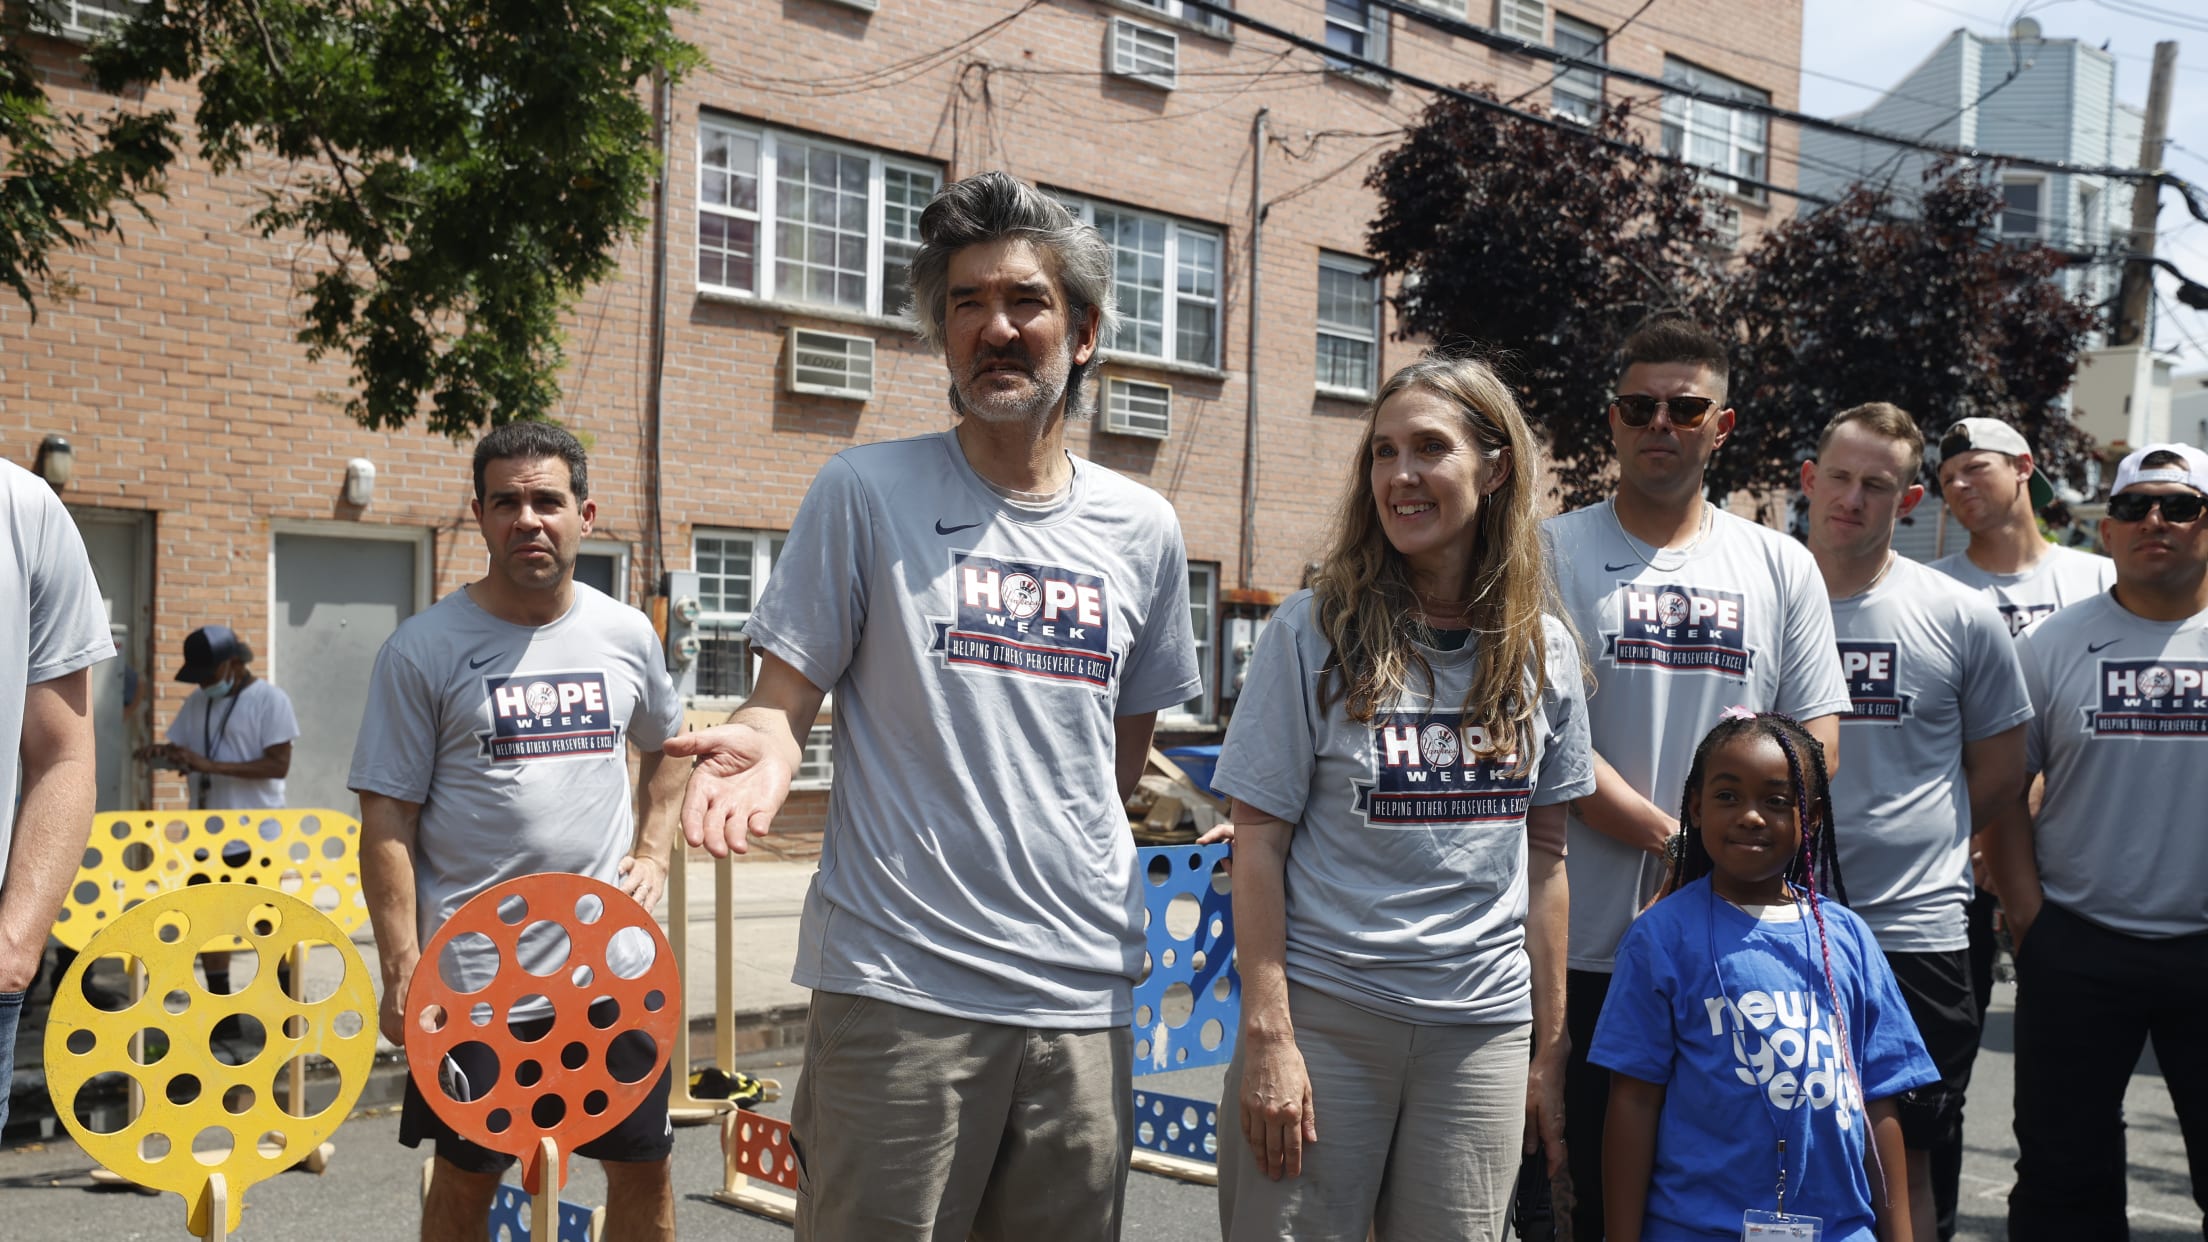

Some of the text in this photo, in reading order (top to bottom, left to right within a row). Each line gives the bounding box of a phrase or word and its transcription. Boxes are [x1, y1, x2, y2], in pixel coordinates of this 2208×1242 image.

[963, 567, 1102, 627] HOPE
[1628, 591, 1739, 629] HOPE
[985, 613, 1086, 640] WEEK
[1645, 624, 1723, 639] WEEK
[953, 640, 1106, 679] HELPING OTHERS PERSEVERE & EXCEL
[1619, 645, 1649, 659] HELPING
[1673, 651, 1713, 664] PERSEVERE
[1714, 653, 1719, 665] &
[1721, 655, 1742, 670] EXCEL
[1843, 652, 1890, 680] PE
[495, 681, 604, 718] HOPE
[1875, 704, 1896, 715] EXCEL
[2123, 699, 2207, 708] WEEK
[516, 714, 593, 728] WEEK
[2099, 718, 2129, 730] HELPING
[2160, 719, 2198, 731] PERSEVERE
[495, 741, 525, 756] HELPING
[526, 739, 550, 754] OTHERS
[552, 738, 589, 752] PERSEVERE
[590, 739, 595, 749] &
[1407, 770, 1506, 782] WEEK
[1375, 800, 1412, 817] HELPING
[1416, 800, 1447, 816] OTHERS
[1452, 799, 1498, 816] PERSEVERE
[1502, 800, 1507, 813] &
[1704, 990, 1819, 1036] new
